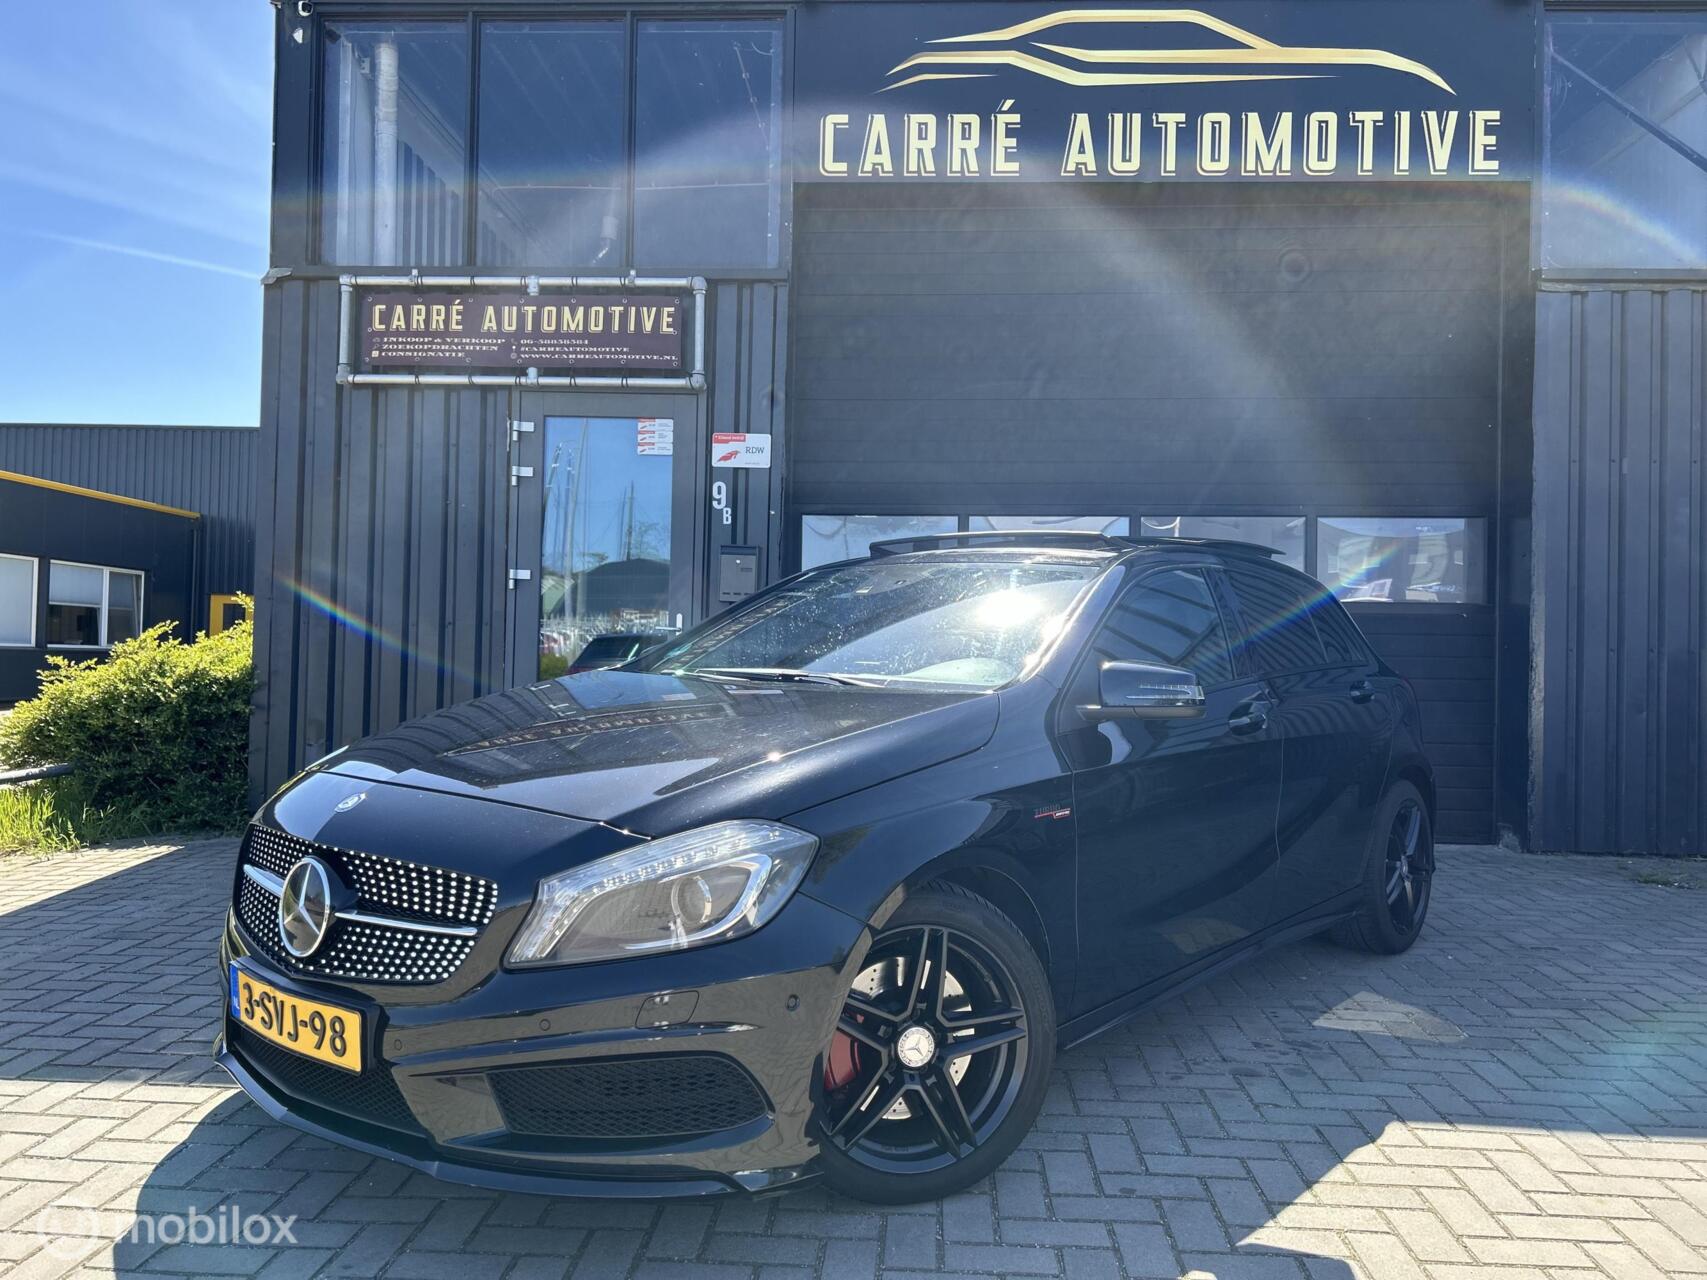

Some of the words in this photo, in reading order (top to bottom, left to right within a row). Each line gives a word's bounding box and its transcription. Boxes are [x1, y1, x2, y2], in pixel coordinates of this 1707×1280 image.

[819, 99, 1021, 176] CARRÉ
[1060, 110, 1501, 176] AUTOMOTIVE
[372, 299, 464, 332] CARRÉ
[481, 305, 676, 334] AUTOMOTIVE
[745, 446, 765, 454] RDW
[712, 481, 727, 509] 9
[723, 507, 732, 524] B
[242, 982, 347, 1057] 3-SVJ-98
